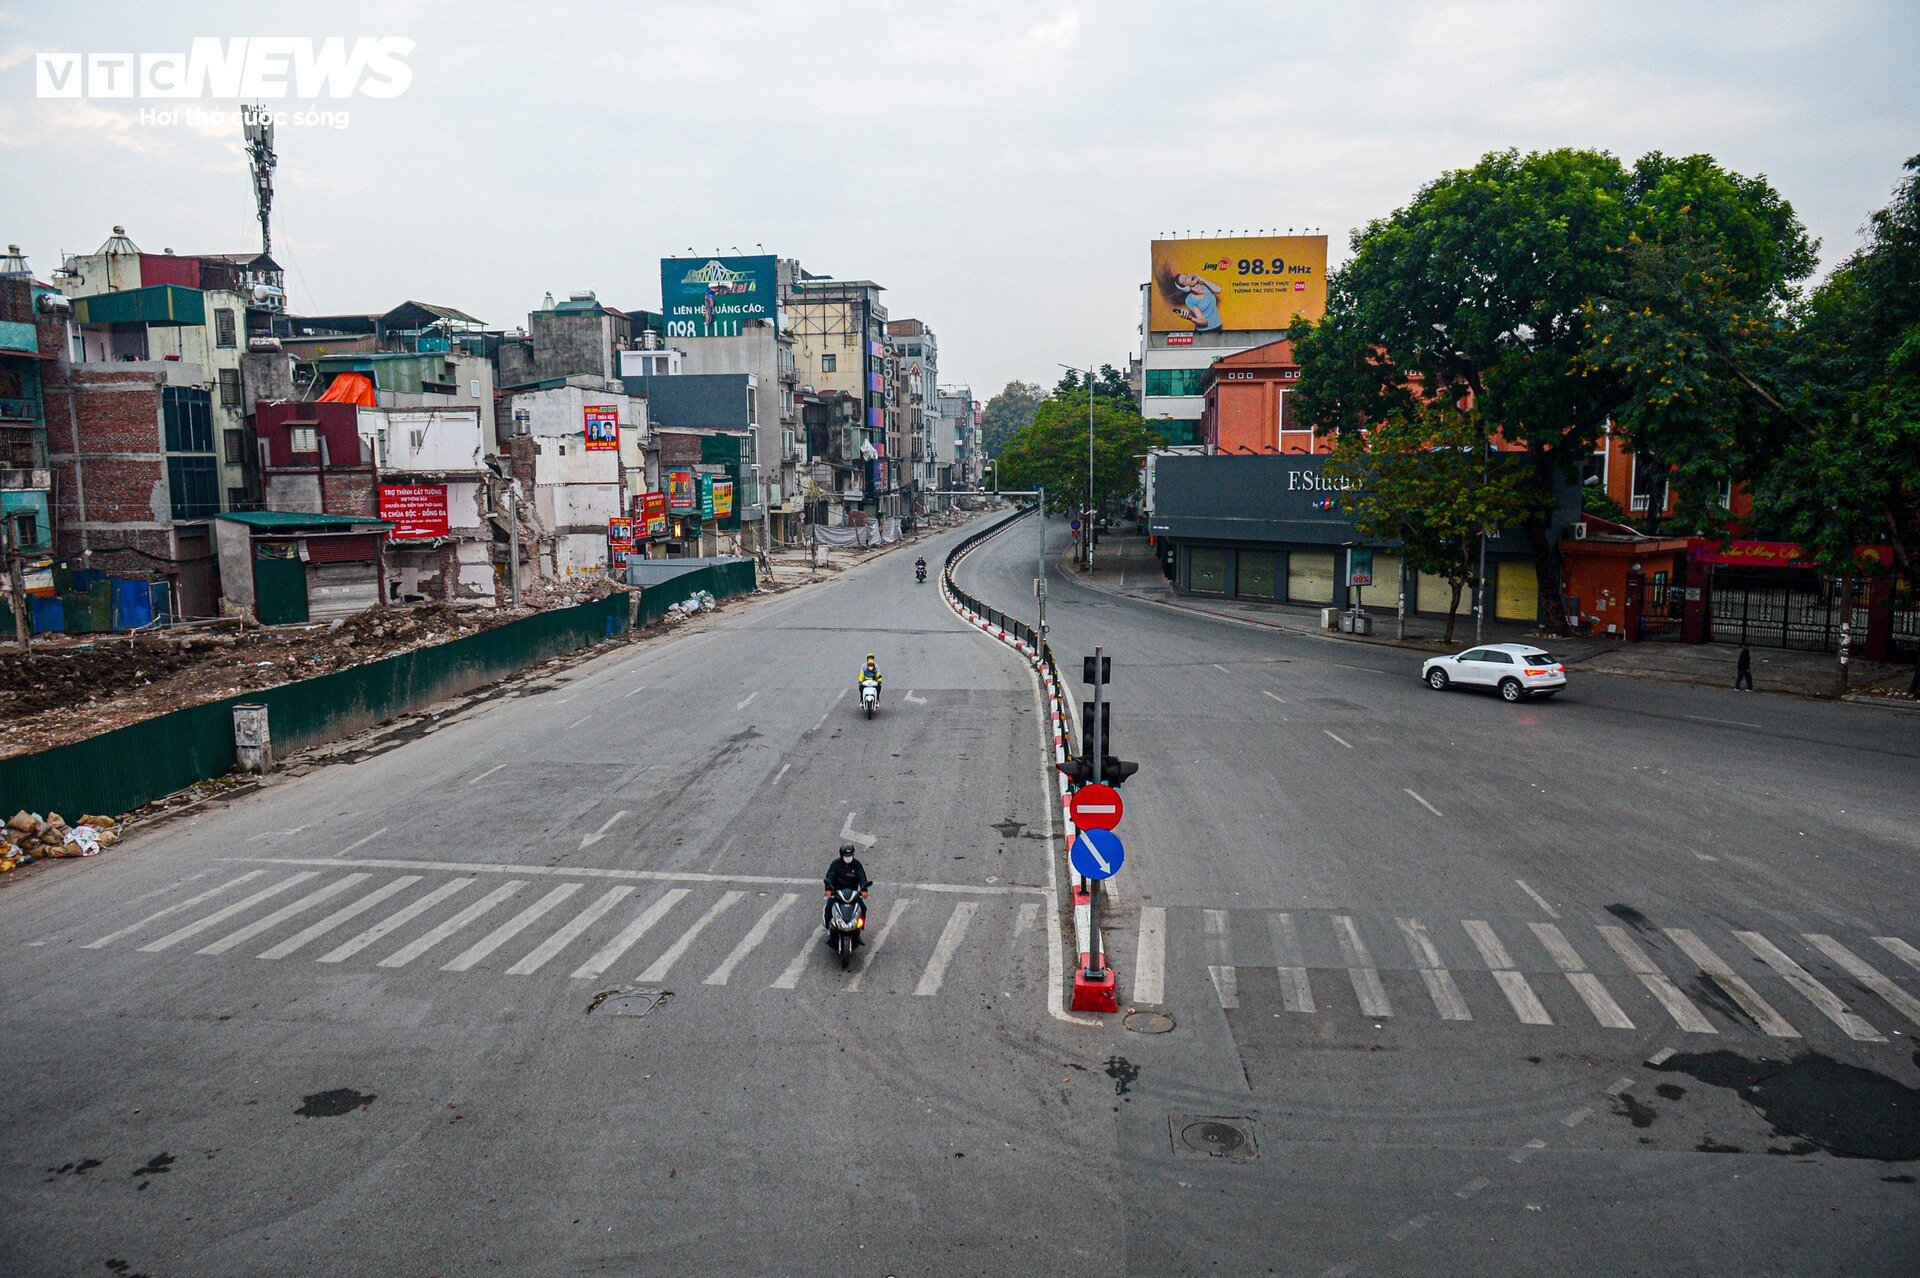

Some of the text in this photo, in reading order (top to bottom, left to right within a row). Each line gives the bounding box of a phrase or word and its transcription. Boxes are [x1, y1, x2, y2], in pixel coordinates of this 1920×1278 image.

[1237, 258, 1285, 276] 98.9
[1288, 265, 1312, 274] MHz
[673, 303, 765, 316] LIÊN HỆ UẢNG CÁO:
[384, 489, 396, 497] TRỢ
[388, 510, 404, 518] CHÙA
[404, 509, 417, 518] BỘC
[422, 508, 438, 517] ĐỐNG
